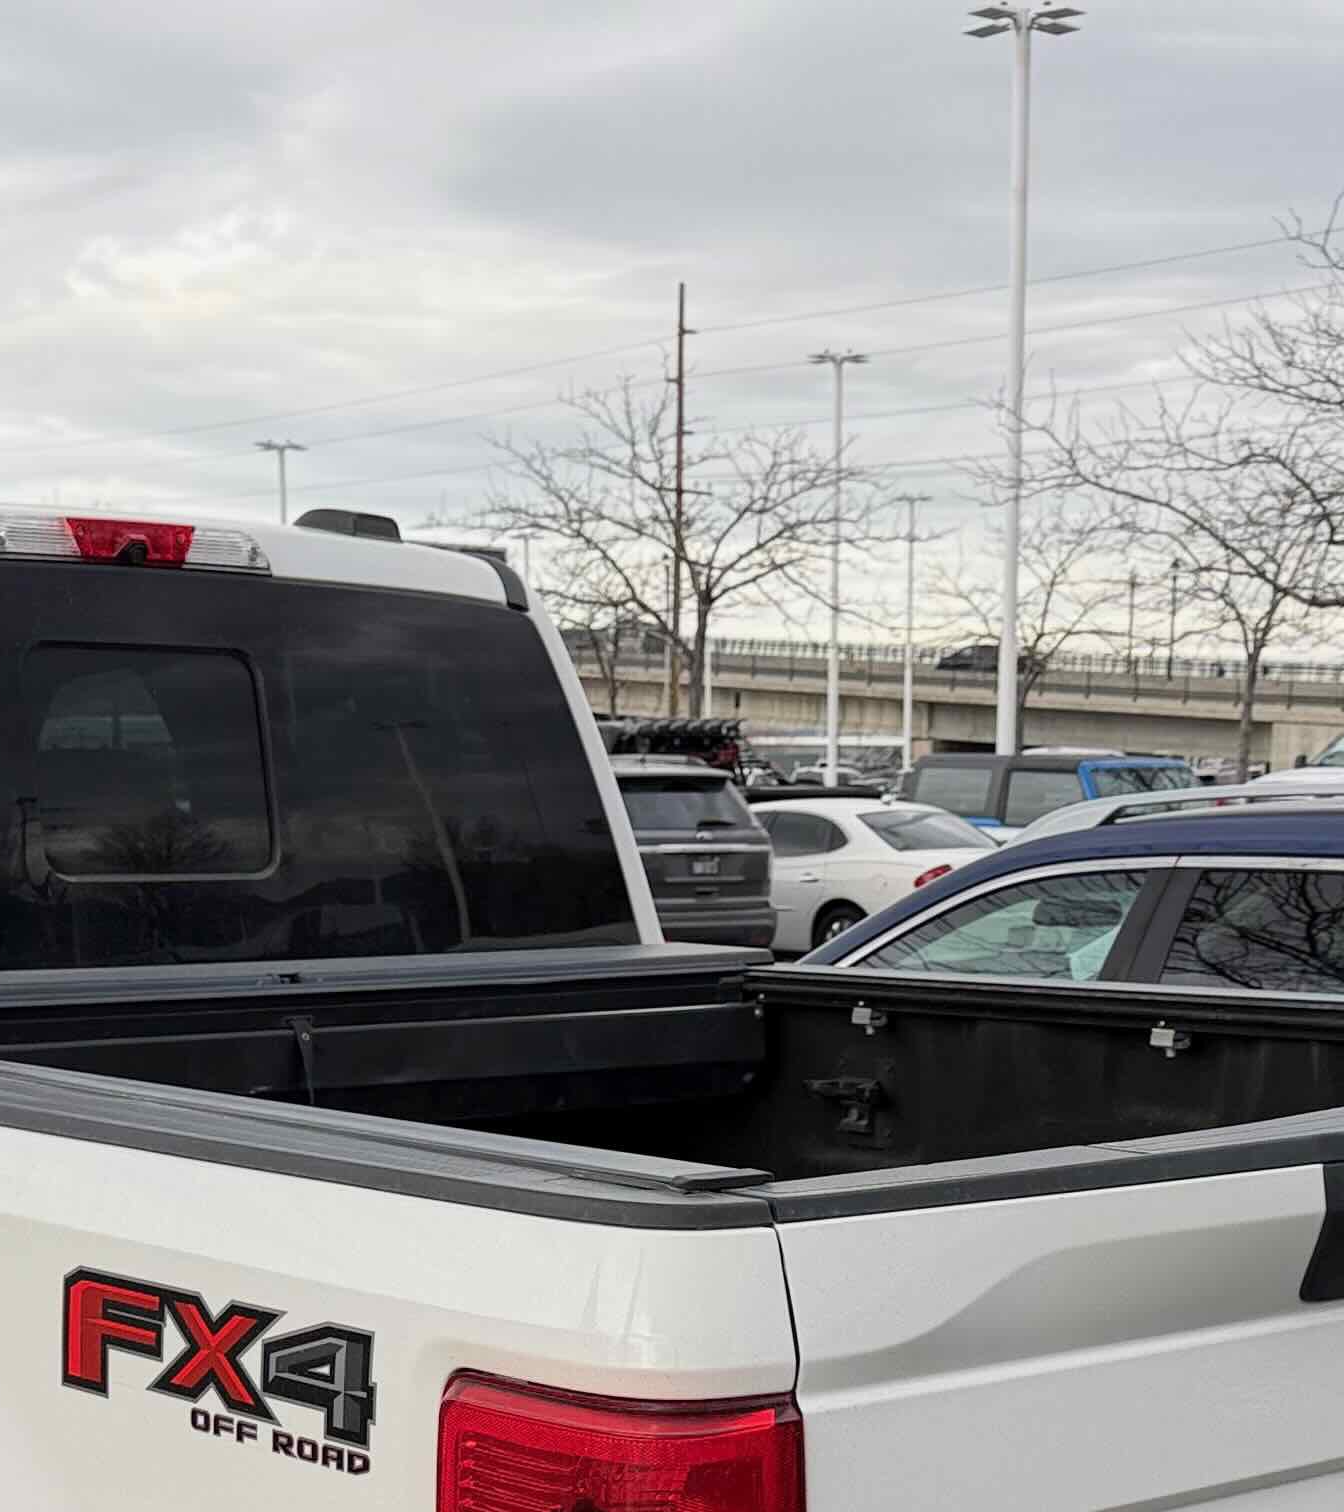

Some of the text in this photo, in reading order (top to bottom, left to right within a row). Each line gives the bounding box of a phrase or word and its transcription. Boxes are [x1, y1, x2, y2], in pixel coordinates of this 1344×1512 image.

[61, 1265, 378, 1451] FX4
[191, 1406, 371, 1476] OFF ROAD
